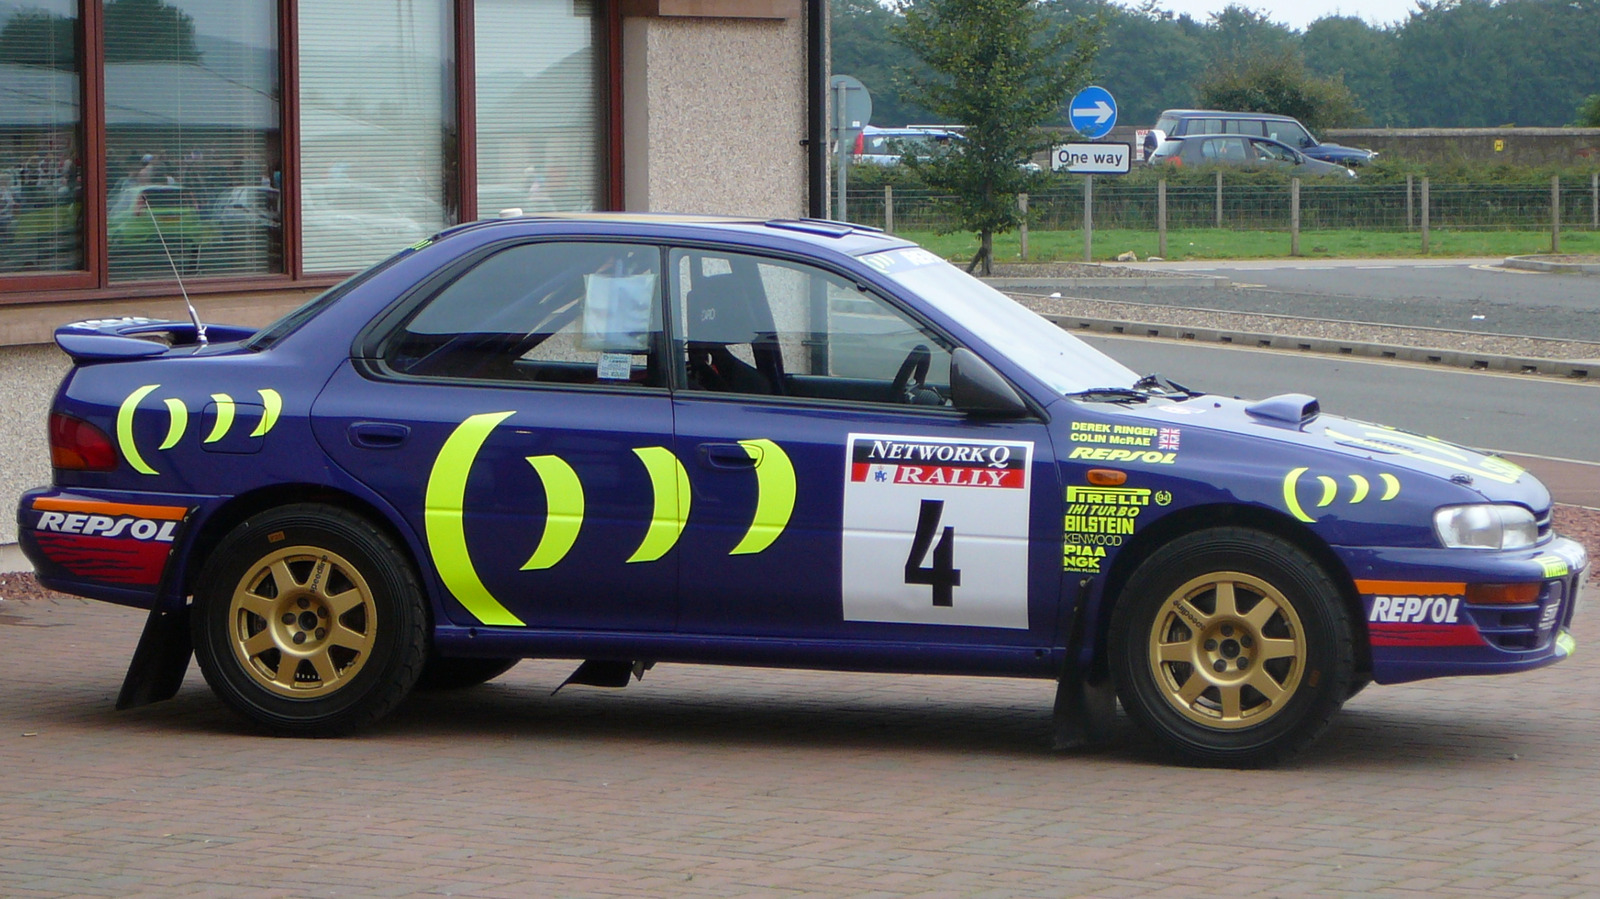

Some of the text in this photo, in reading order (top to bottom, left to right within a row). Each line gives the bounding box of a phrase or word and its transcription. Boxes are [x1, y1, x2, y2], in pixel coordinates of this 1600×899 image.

[1058, 150, 1123, 167] One way
[1071, 422, 1158, 437] DEREK RINGER
[1070, 433, 1151, 446] COLIN McRAE
[868, 441, 1010, 468] NETWORK Q
[1069, 447, 1177, 464] REPSOL
[897, 466, 1010, 487] RALLY
[1066, 485, 1152, 506] PIRELLI
[1158, 493, 1168, 502] 94
[1067, 504, 1140, 517] IHI TURBO
[36, 511, 177, 542] REPSOL
[1065, 515, 1135, 534] BILSTEIN
[1063, 533, 1123, 546] KENWOOD
[904, 499, 961, 607] 4
[1063, 545, 1107, 557] PIAA
[1063, 556, 1101, 568] NGK
[309, 554, 329, 593] speedline
[1172, 599, 1206, 631] speedline
[1369, 597, 1460, 623] REPSOL
